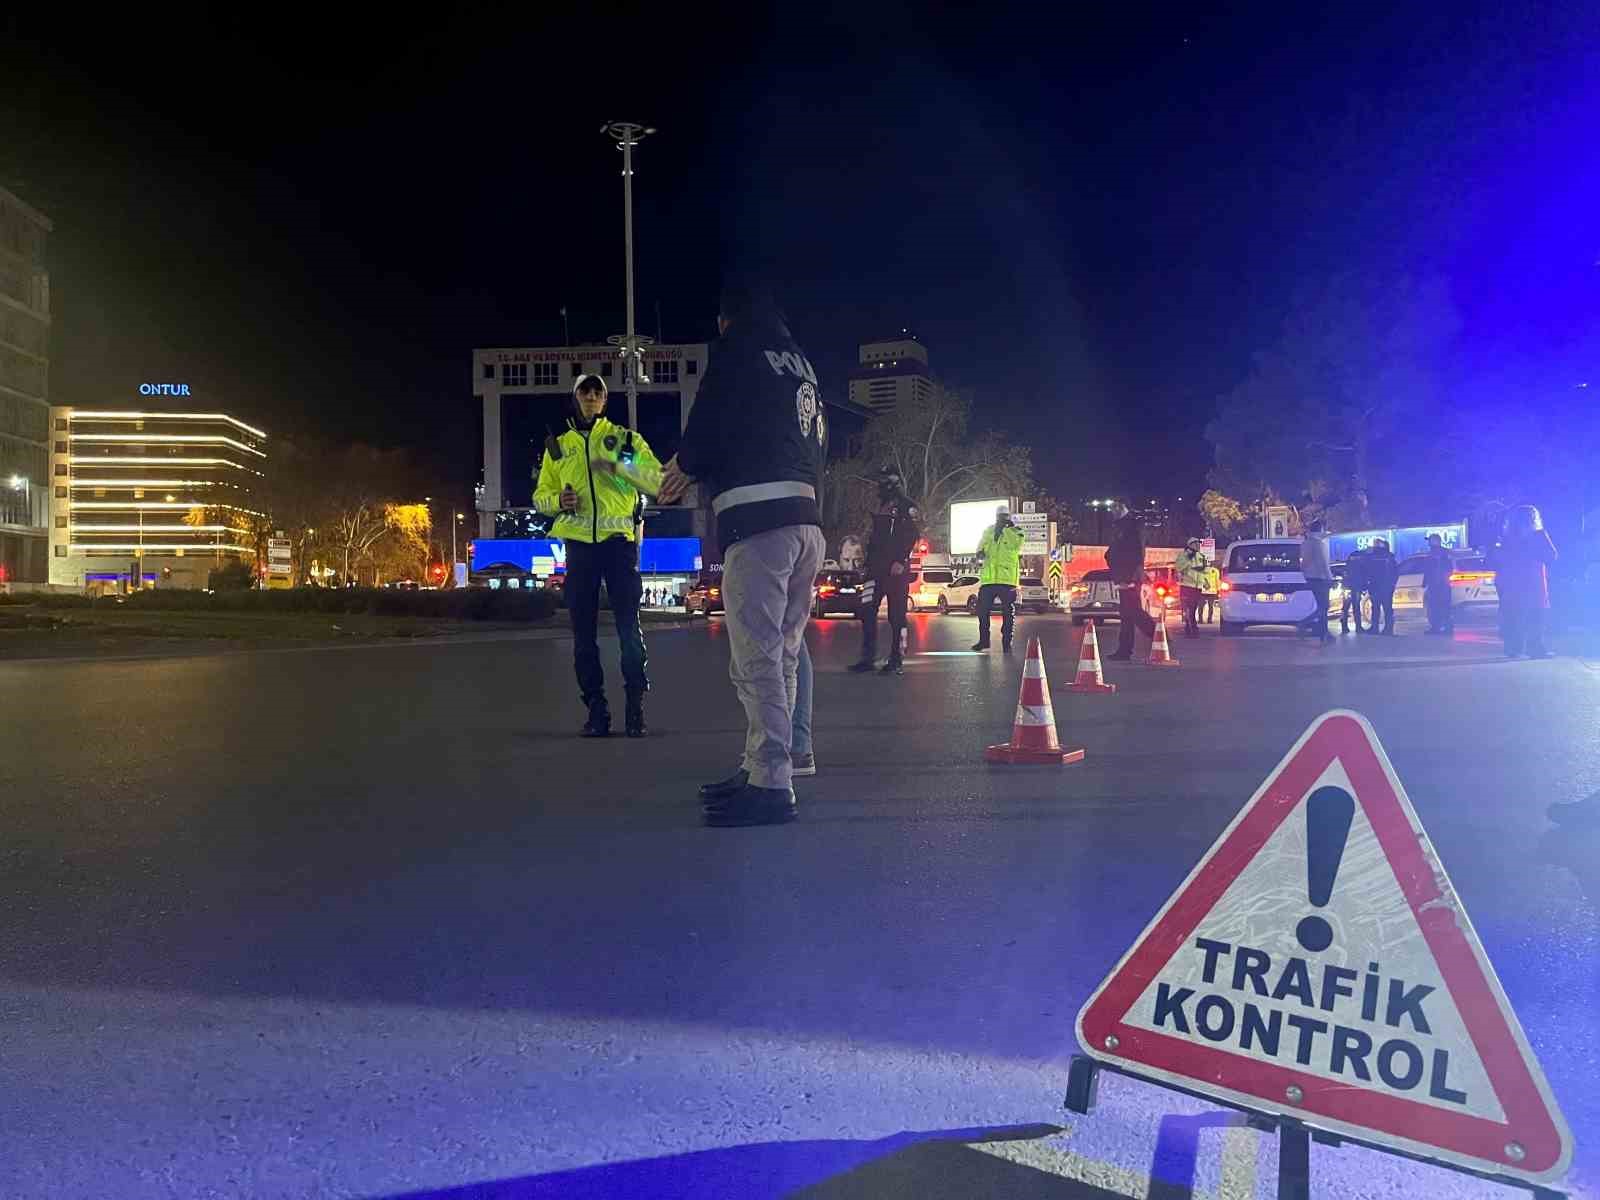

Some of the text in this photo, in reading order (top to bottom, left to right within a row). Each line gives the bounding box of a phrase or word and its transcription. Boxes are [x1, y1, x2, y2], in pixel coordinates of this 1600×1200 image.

[139, 383, 191, 396] ONTUR
[1195, 937, 1436, 1036] TRAFİK
[1152, 982, 1468, 1106] KONTROL
